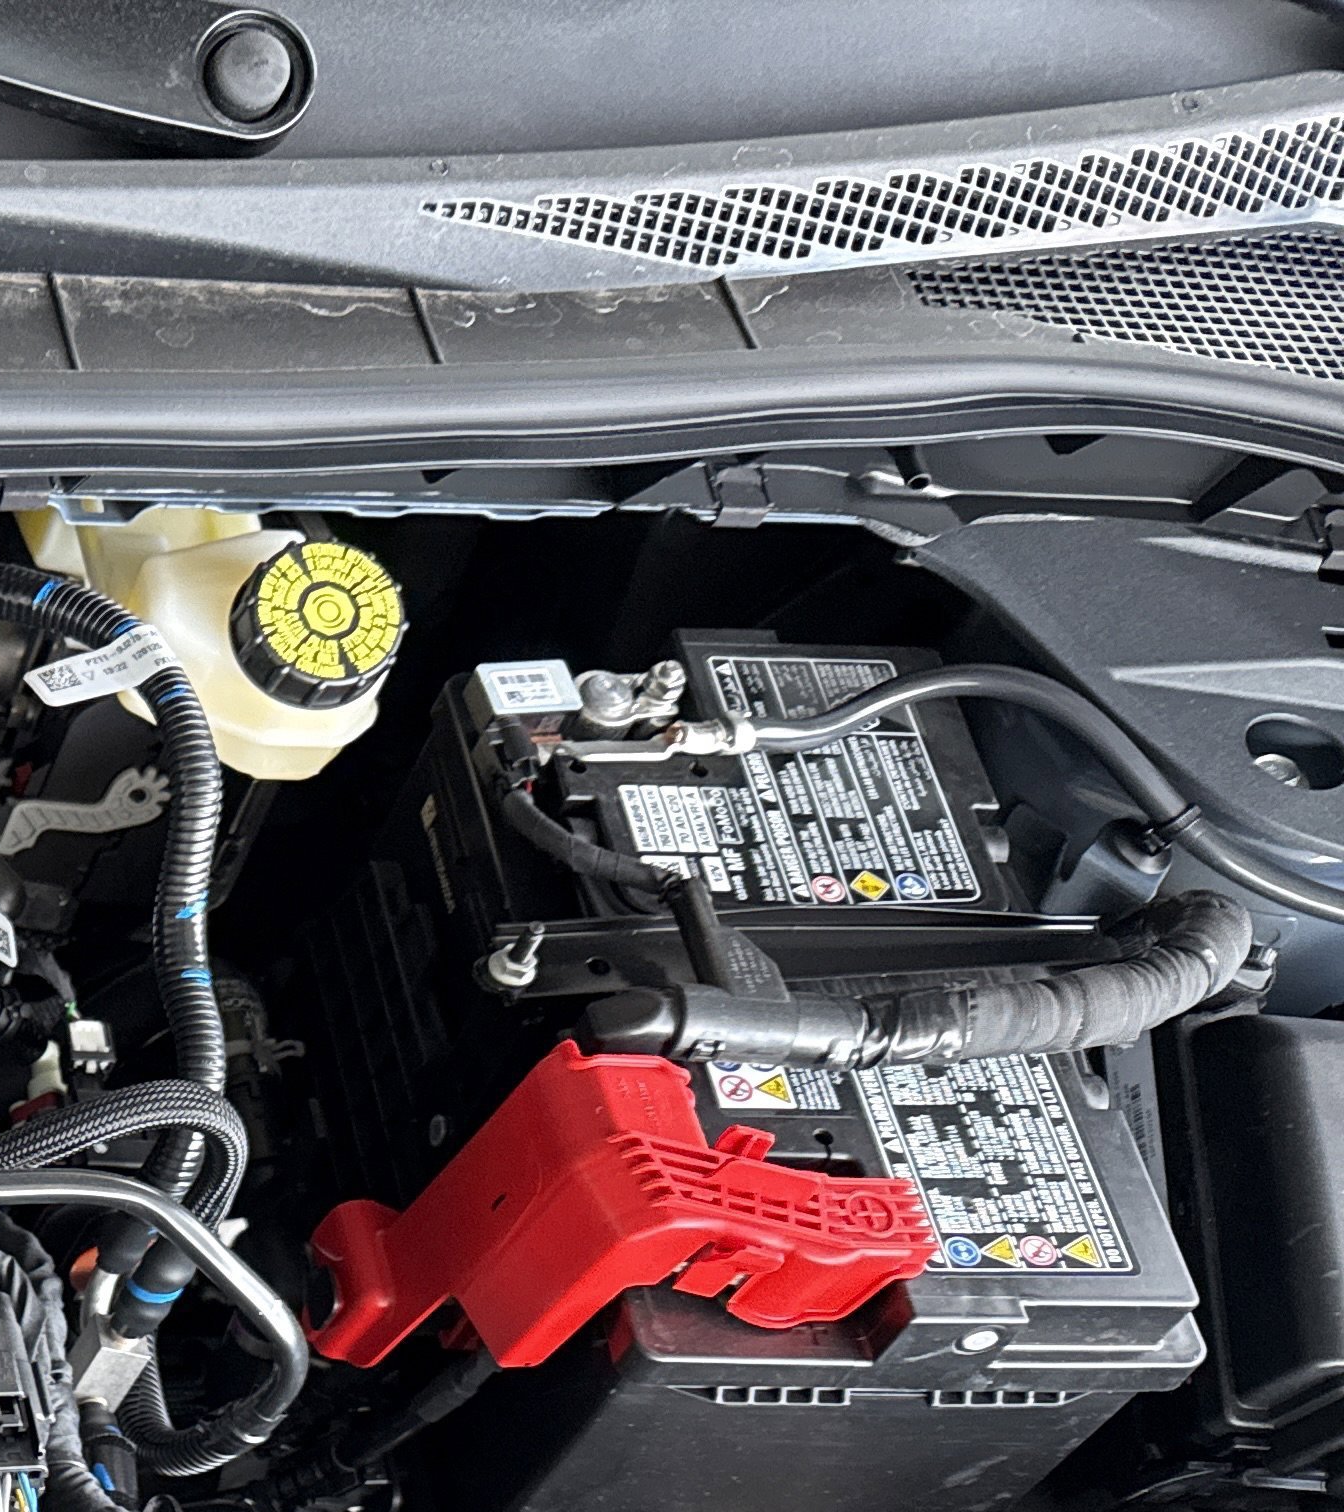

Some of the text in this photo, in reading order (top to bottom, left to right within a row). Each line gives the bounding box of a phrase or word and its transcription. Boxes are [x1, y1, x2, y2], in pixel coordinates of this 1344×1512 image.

[745, 752, 773, 789] PELIGRO
[705, 789, 738, 840] FoMoCo
[765, 809, 805, 883] DANGER POISON
[1027, 1064, 1051, 1090] ABRA.
[1039, 1091, 1057, 1104] LA
[1045, 1106, 1063, 1117] NO
[1068, 1162, 1088, 1179] PAS
[1076, 1181, 1094, 1193] NE
[1083, 1199, 1108, 1226] OPEN.
[1095, 1228, 1117, 1247] NOT
[1104, 1249, 1123, 1262] DO
